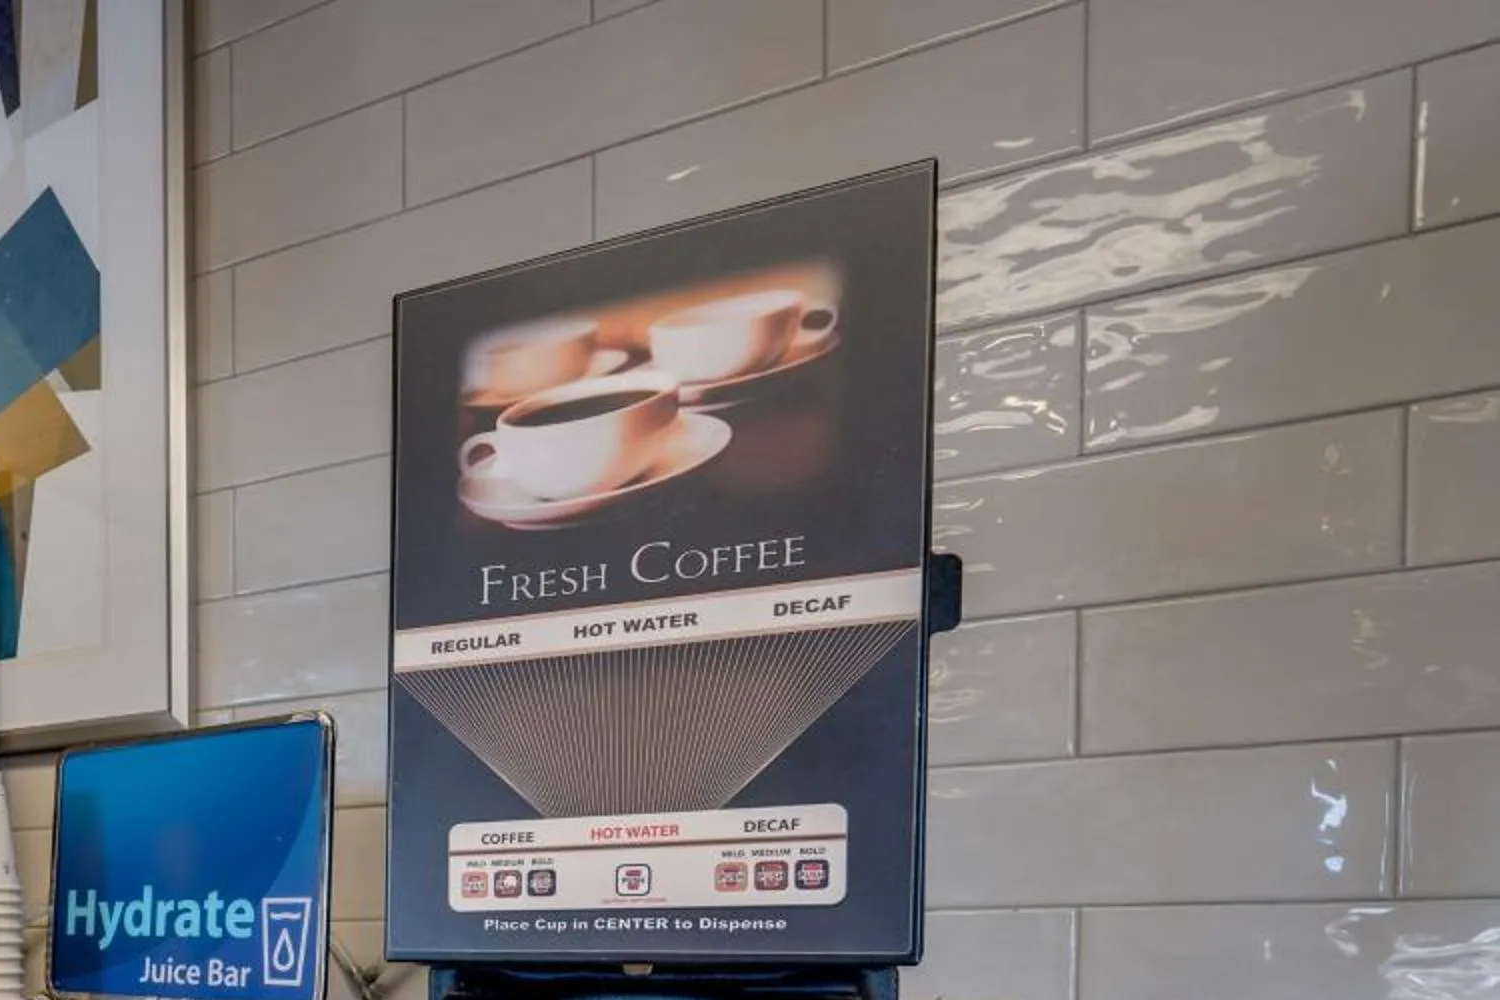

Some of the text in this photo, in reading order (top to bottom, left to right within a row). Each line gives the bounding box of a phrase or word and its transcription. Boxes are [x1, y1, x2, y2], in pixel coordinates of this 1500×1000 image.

[480, 535, 805, 605] FRESH COFFEE
[773, 595, 852, 616] DECAF
[573, 612, 699, 639] HOT WATER
[431, 632, 521, 655] REGULAR
[590, 824, 680, 841] HOT WATER
[743, 818, 801, 833] DECAF
[481, 831, 536, 845] COFFEE
[66, 885, 255, 950] Hydrate
[483, 917, 788, 932] Place Cup in CENTER to Dispense
[139, 956, 252, 987] Juice Bar
